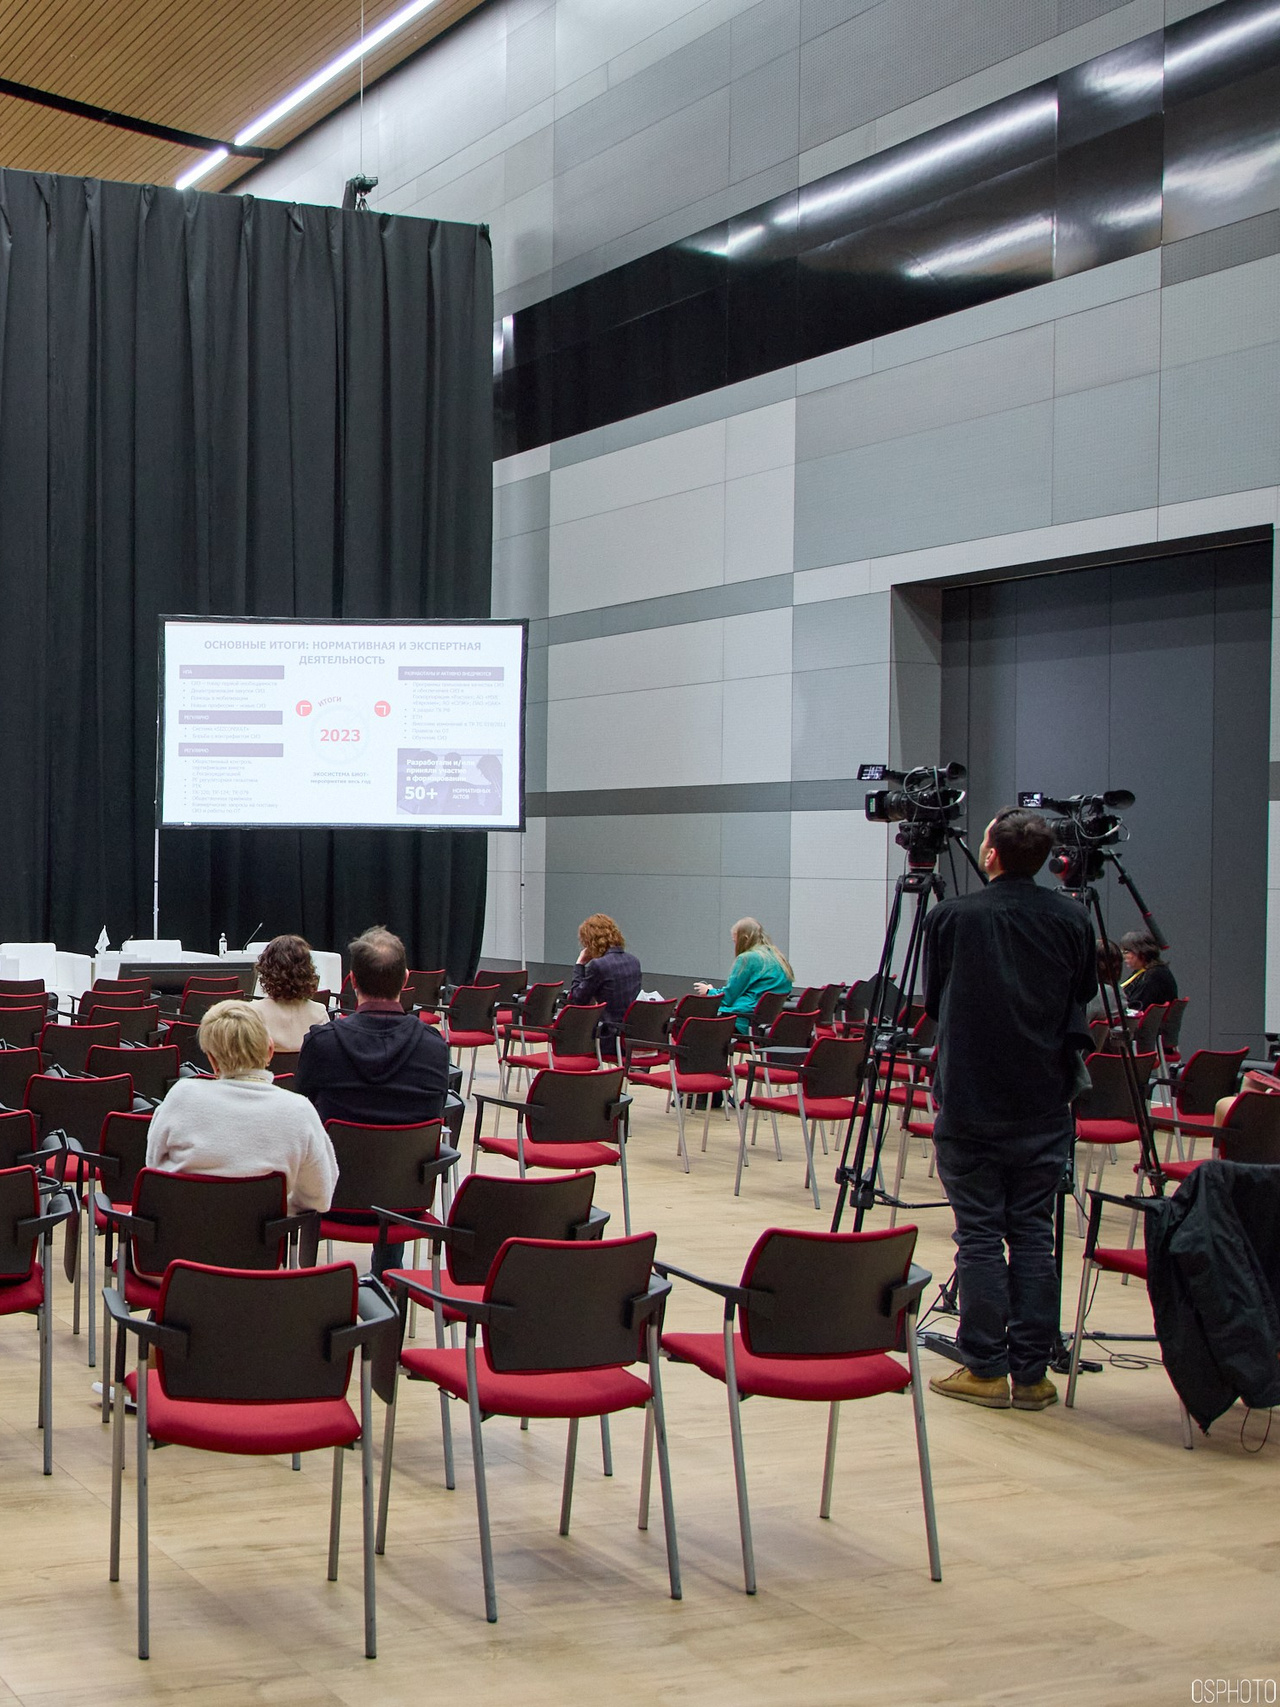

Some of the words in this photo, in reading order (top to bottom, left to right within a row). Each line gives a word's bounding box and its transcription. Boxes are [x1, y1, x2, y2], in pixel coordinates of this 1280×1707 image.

[204, 641, 266, 650] ОСНОВНЫЕ
[270, 641, 309, 650] ИТОГИ:
[312, 641, 395, 650] НОРМАТИВНАЯ
[399, 642, 407, 650] И
[409, 641, 481, 651] ЭКСПЕРТНАЯ
[299, 655, 385, 665] ДЕЯТЕЛЬНОСТЬ
[317, 696, 342, 707] ИТОГИ
[320, 729, 361, 742] 2023
[404, 786, 438, 800] 50+
